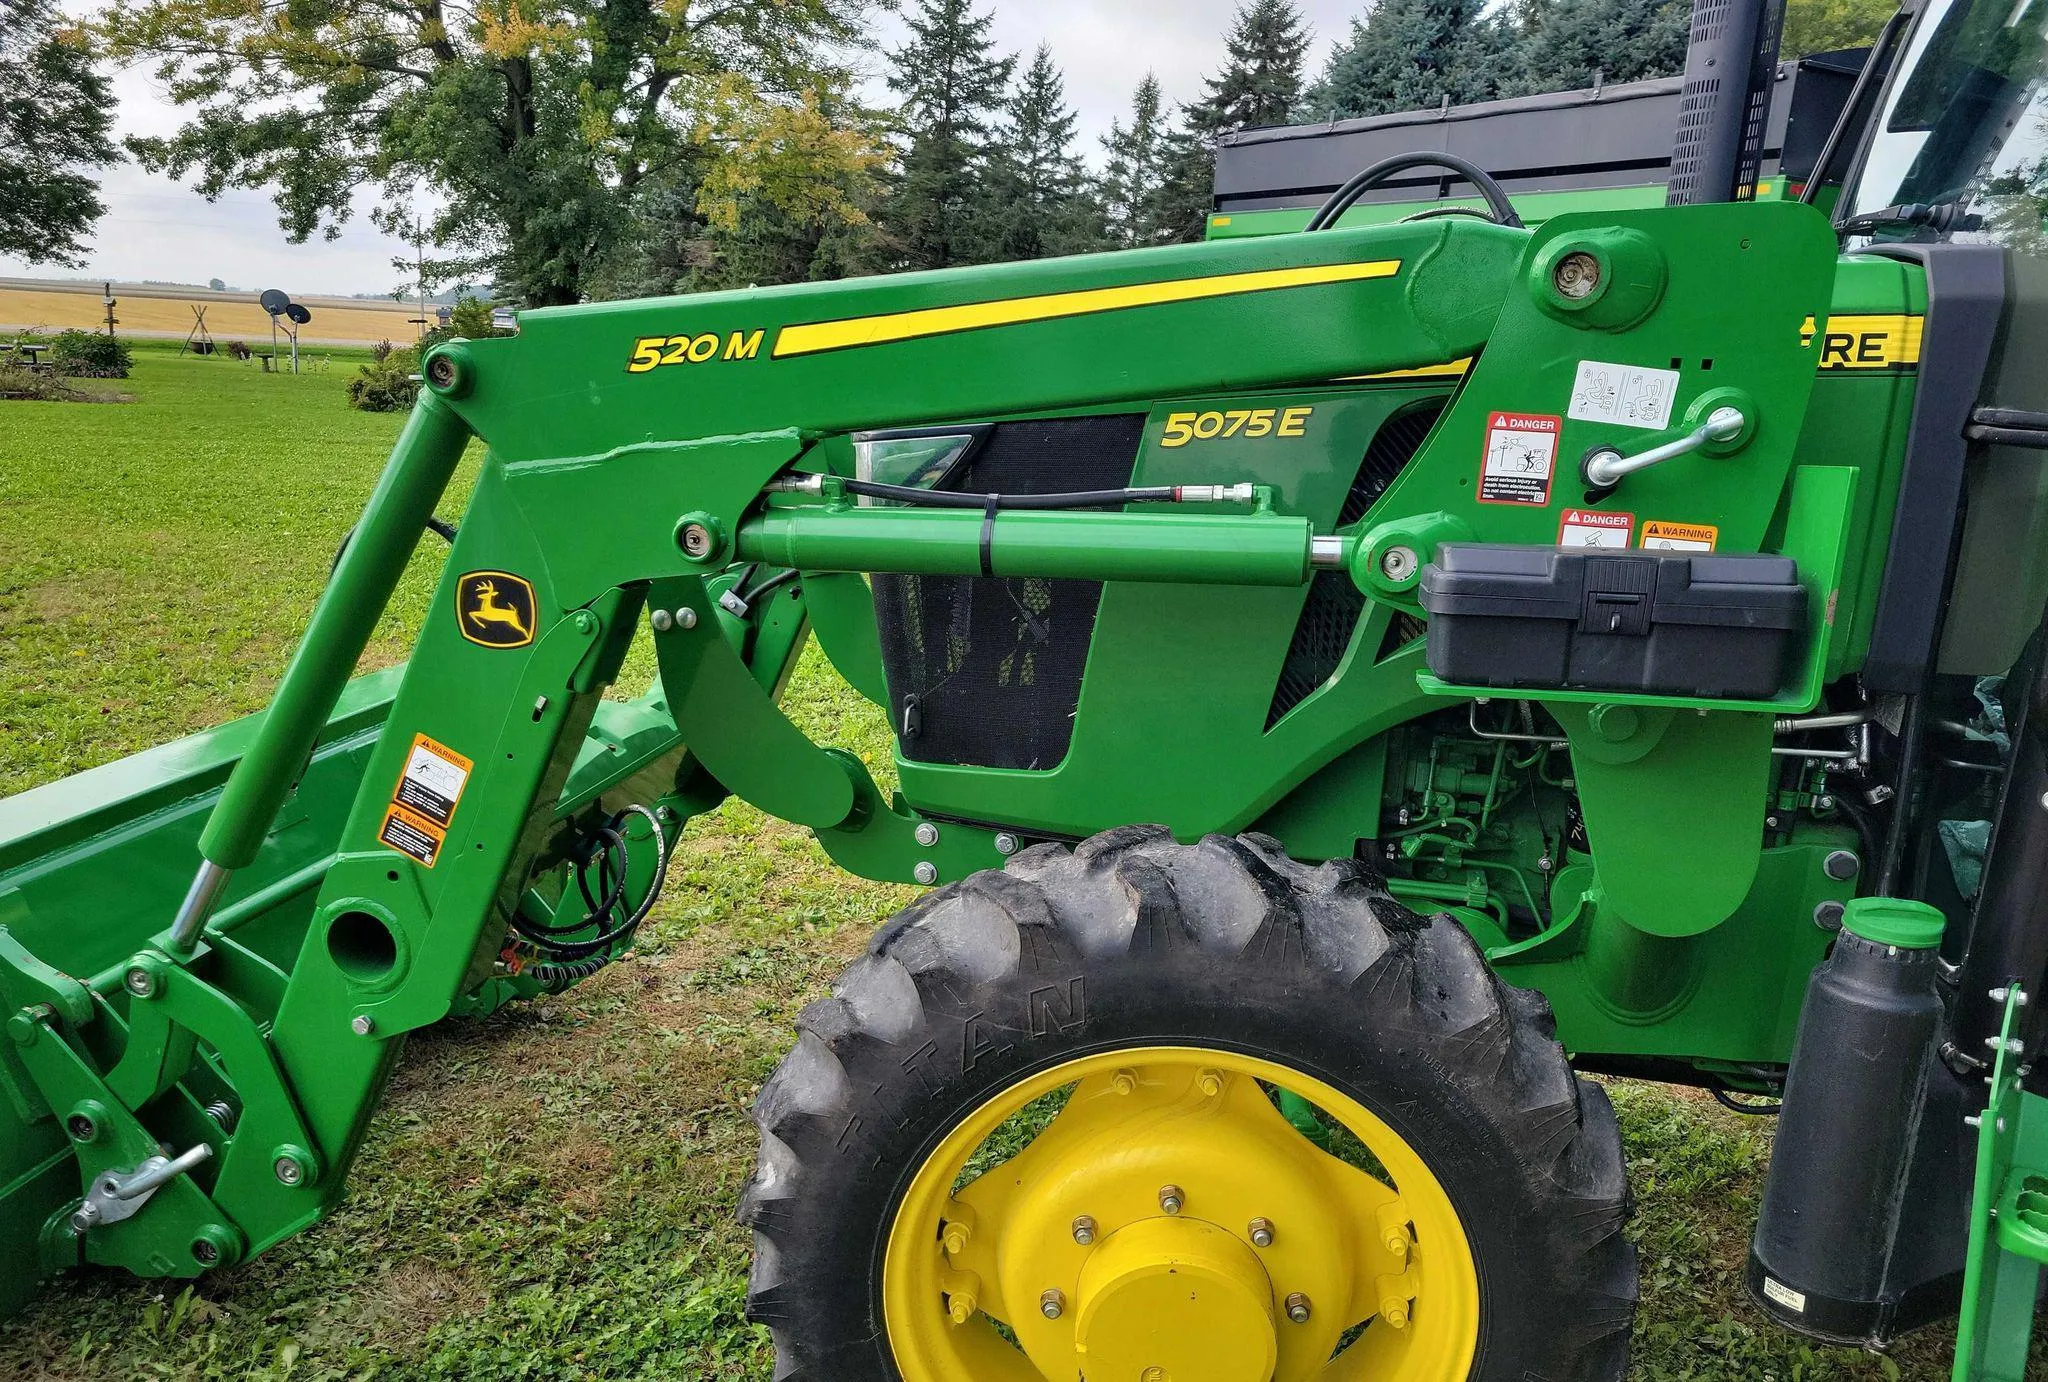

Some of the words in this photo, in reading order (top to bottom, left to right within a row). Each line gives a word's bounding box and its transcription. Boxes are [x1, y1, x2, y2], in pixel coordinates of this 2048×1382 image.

[1510, 418, 1555, 430] DANGER
[1583, 514, 1628, 526] DANGER
[1662, 526, 1713, 539] WARNING
[431, 743, 466, 767] WARNING
[404, 814, 439, 837] WARNING
[1782, 1287, 1795, 1296] LOW
[1785, 1293, 1798, 1303] FUEL
